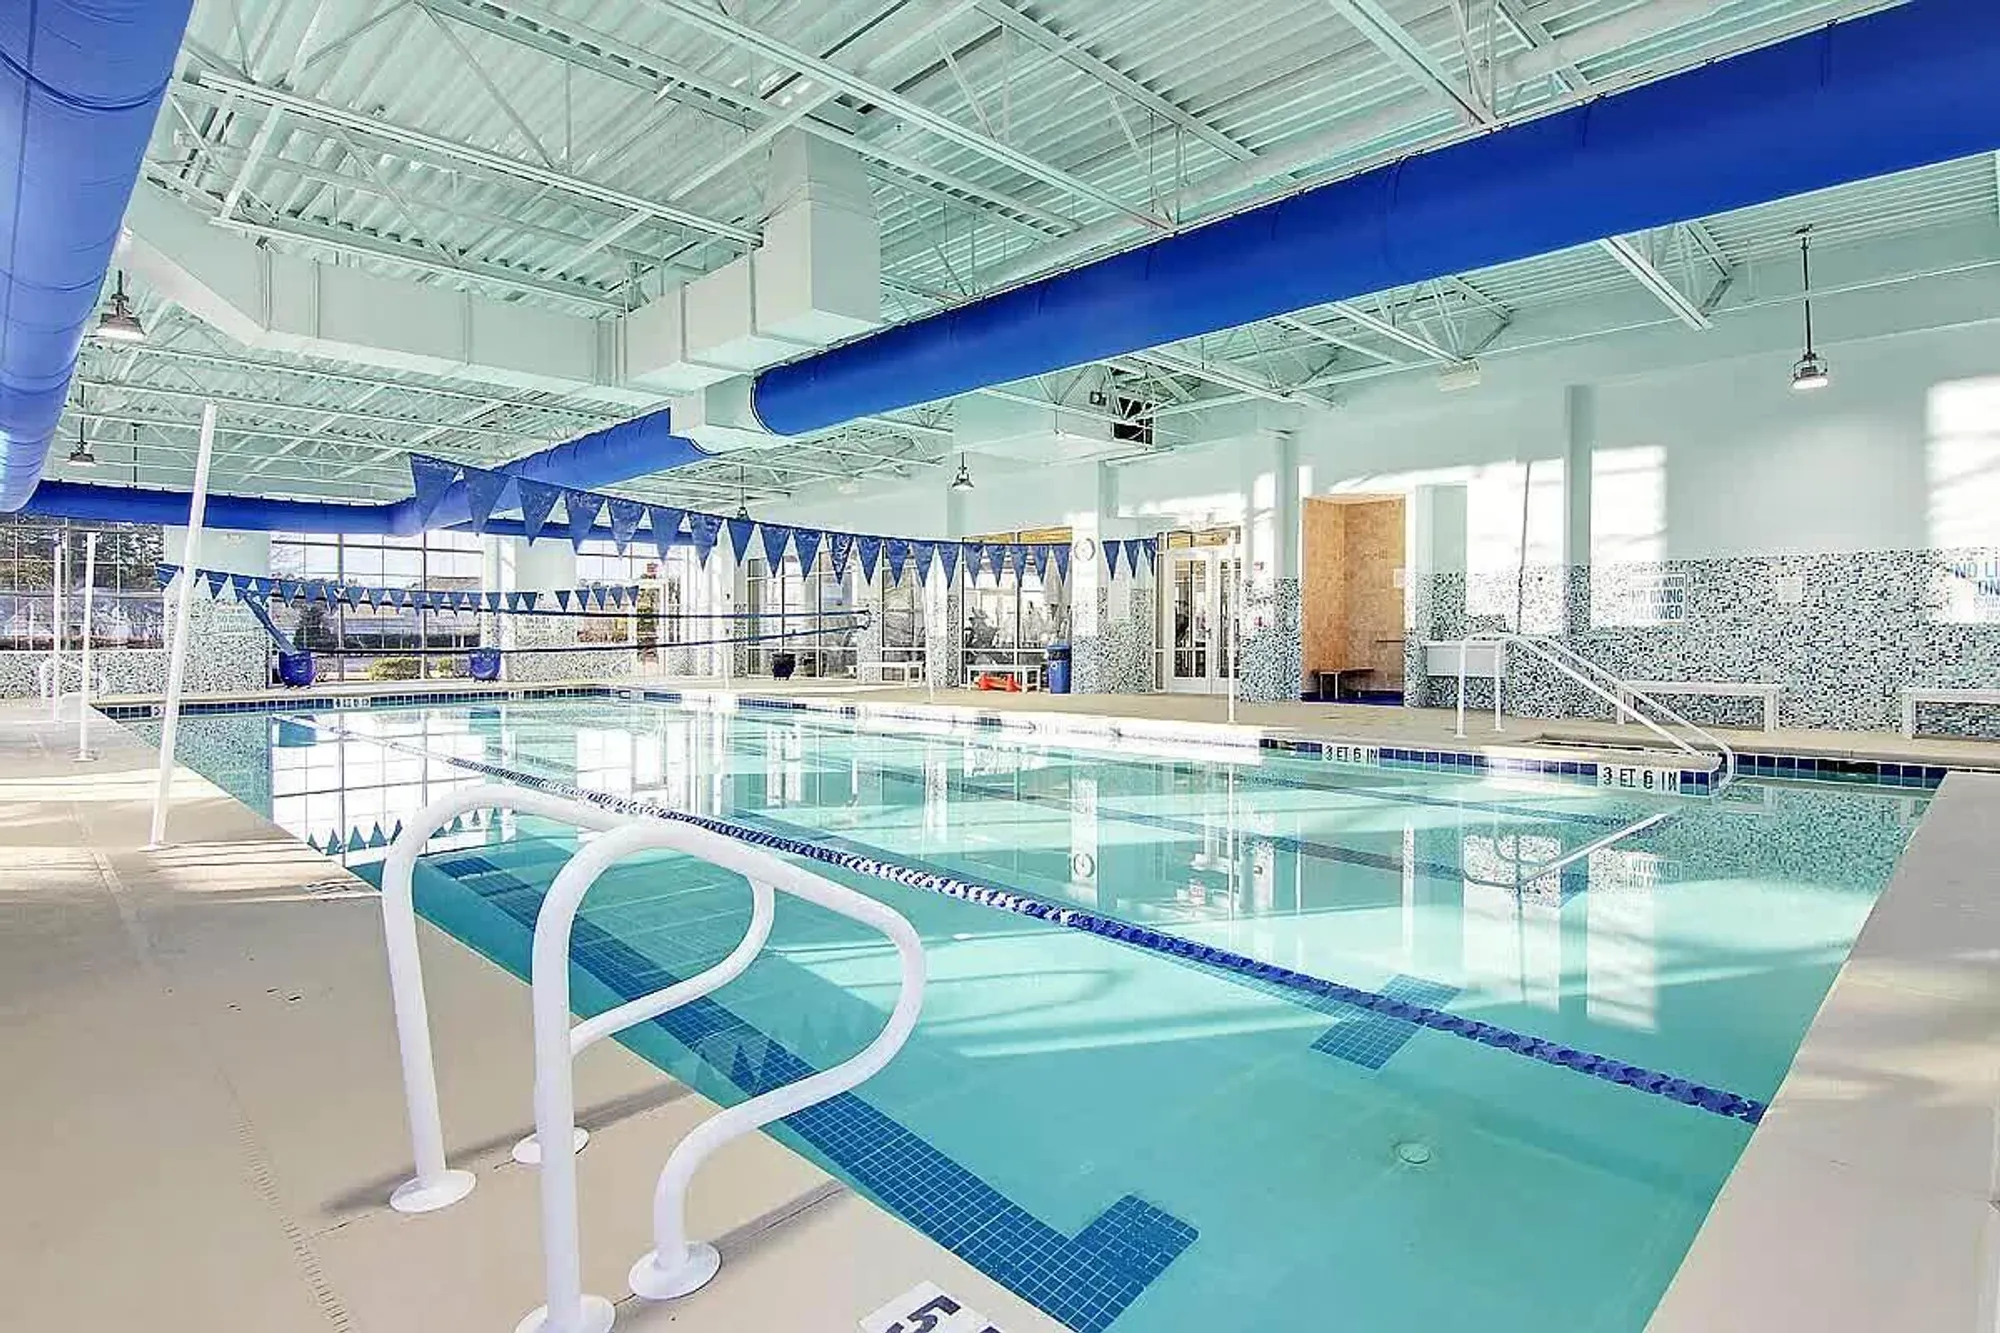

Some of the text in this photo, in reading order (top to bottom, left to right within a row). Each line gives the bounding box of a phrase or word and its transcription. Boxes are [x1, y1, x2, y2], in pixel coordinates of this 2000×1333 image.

[1650, 588, 1683, 604] DIVING
[1325, 744, 1333, 761] 3
[1353, 746, 1362, 763] 6
[1366, 747, 1378, 765] IN
[1603, 766, 1612, 786] 3
[1643, 769, 1654, 789] 6
[1661, 771, 1677, 791] IN
